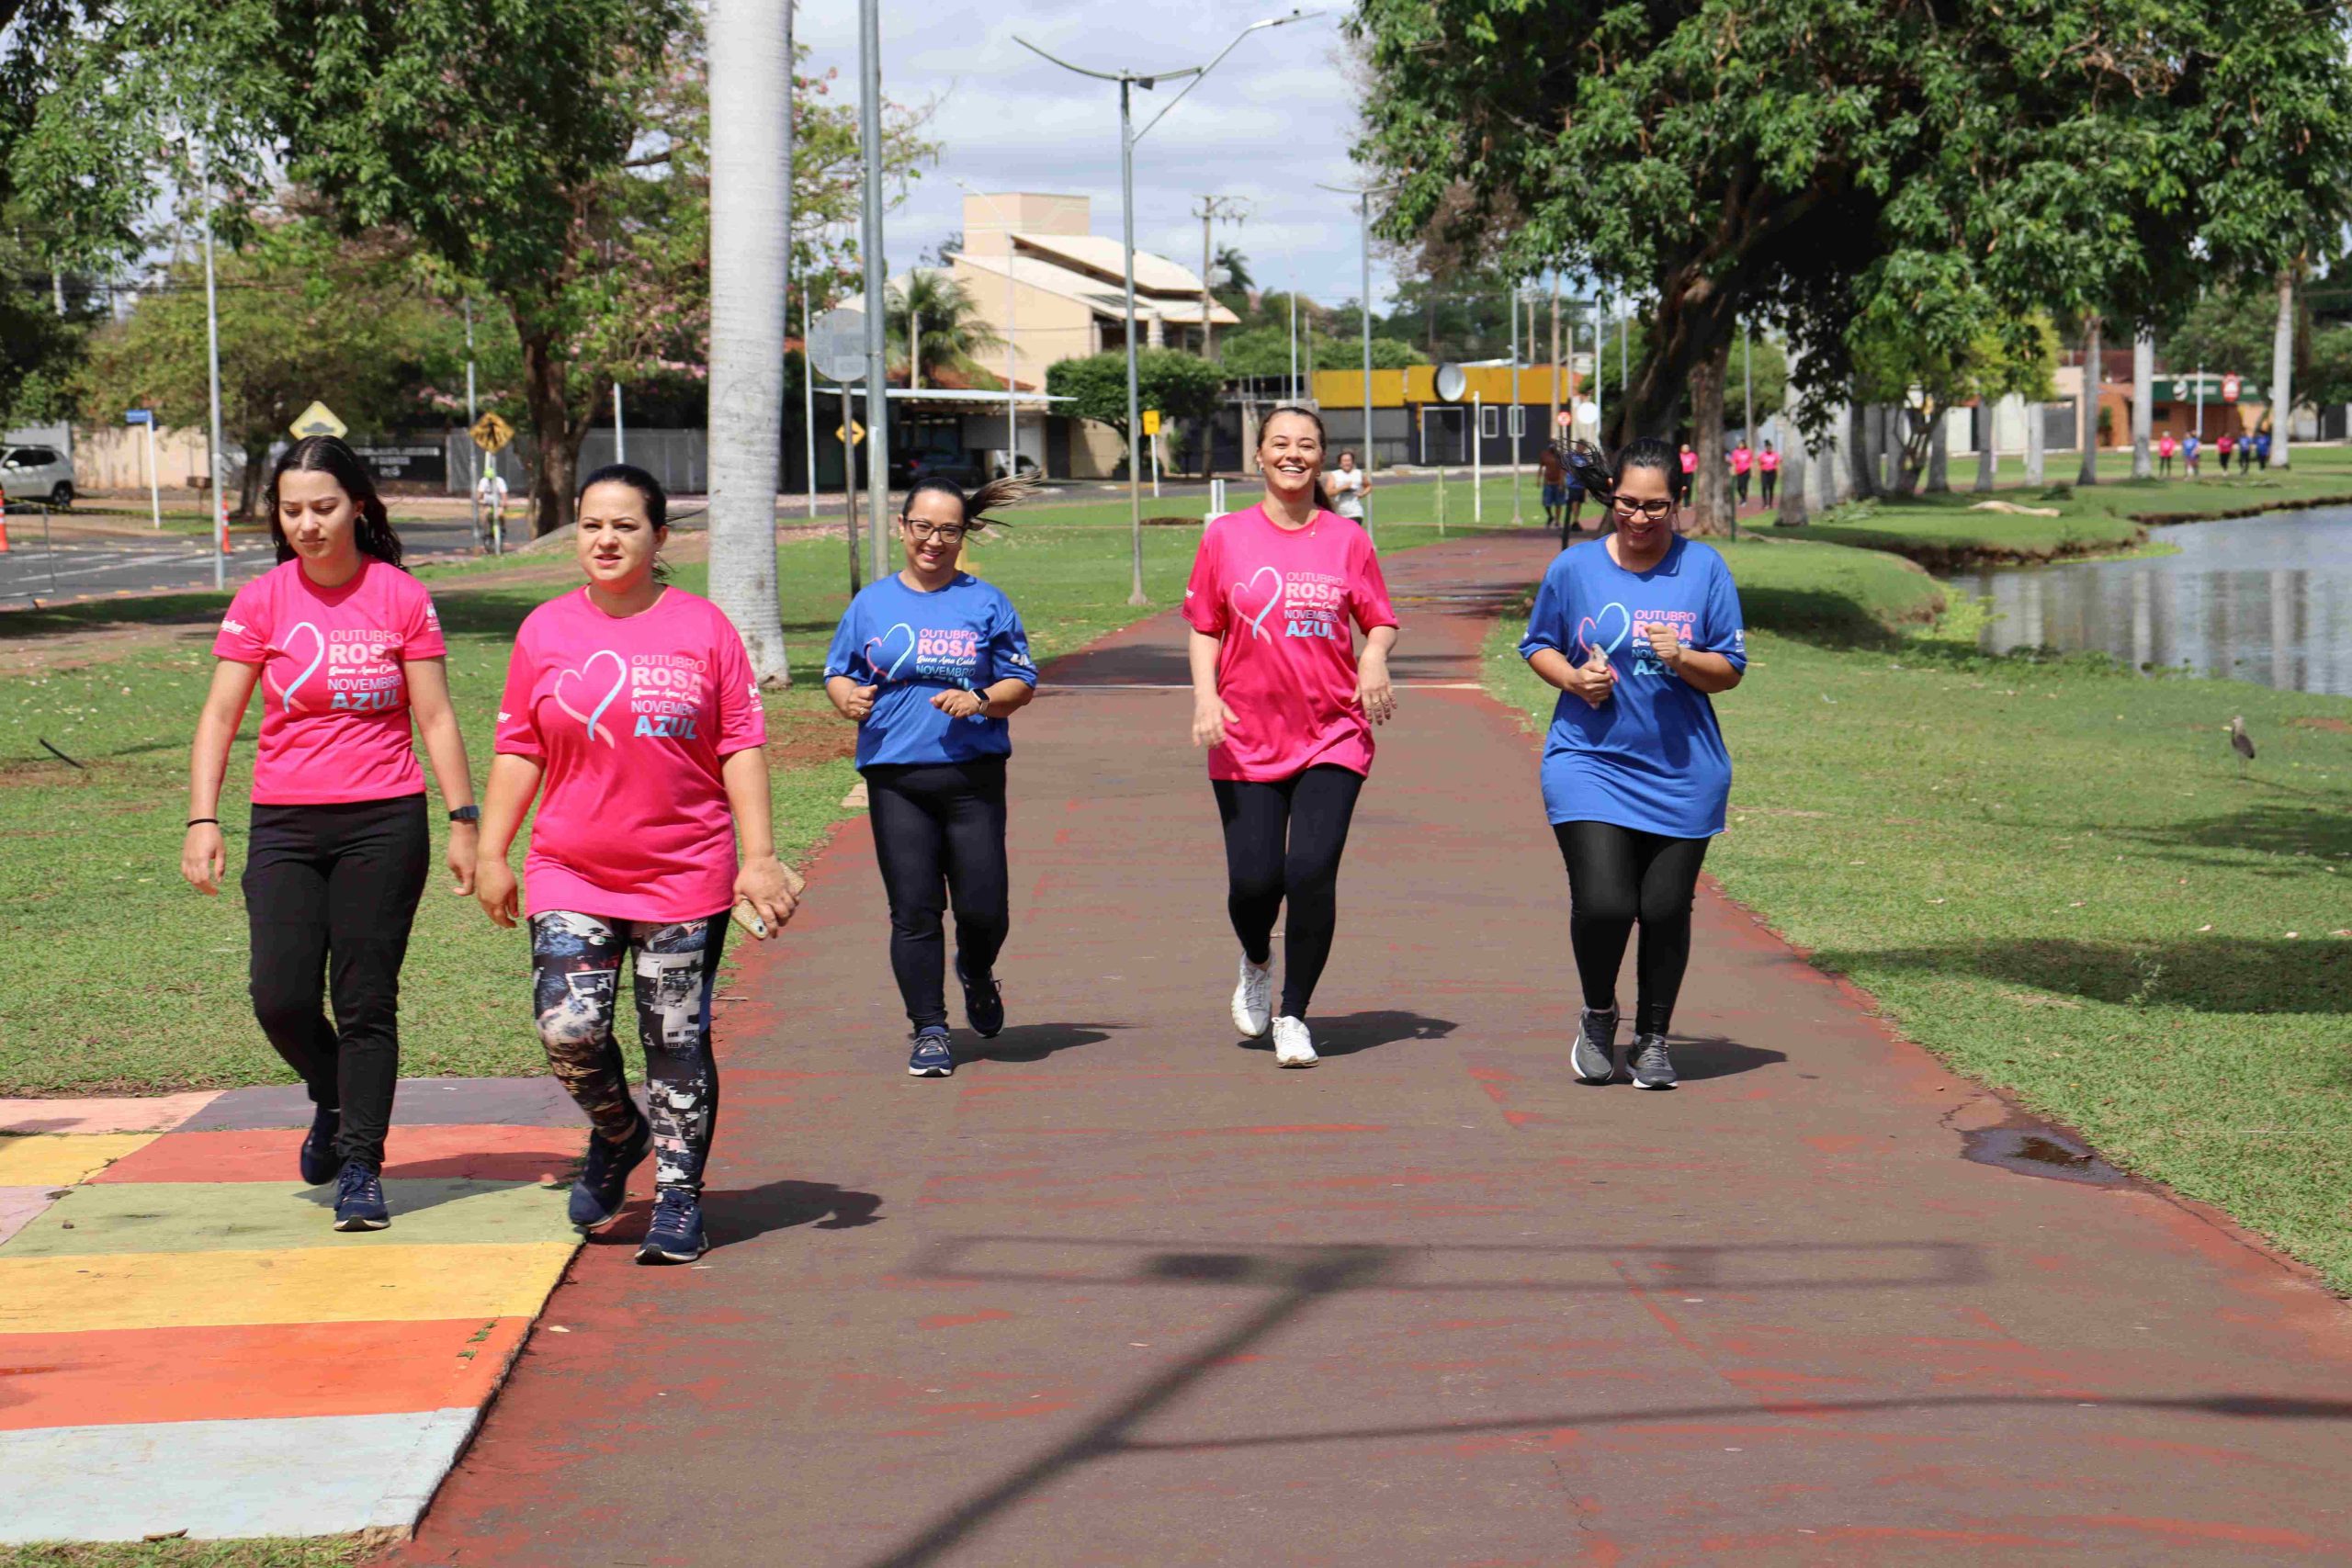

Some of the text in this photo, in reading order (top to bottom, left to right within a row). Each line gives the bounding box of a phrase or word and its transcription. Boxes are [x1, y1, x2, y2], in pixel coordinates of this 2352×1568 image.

[1286, 571, 1344, 586] OUTUBRO
[1285, 582, 1341, 604] ROSA
[1634, 609, 1697, 623] OUTUBRO
[331, 630, 404, 645] OUTUBRO
[920, 628, 978, 641] OUTUBRO
[1285, 620, 1336, 640] AZUL
[329, 643, 401, 664] ROS
[918, 638, 977, 658] ROSA
[631, 654, 707, 673] OUTUBRO
[916, 664, 976, 677] NOVEMBRO
[327, 674, 401, 691] NOVEMBRO
[631, 666, 702, 694] ROSA
[330, 689, 399, 710] AZUL
[634, 715, 698, 739] AZUL
